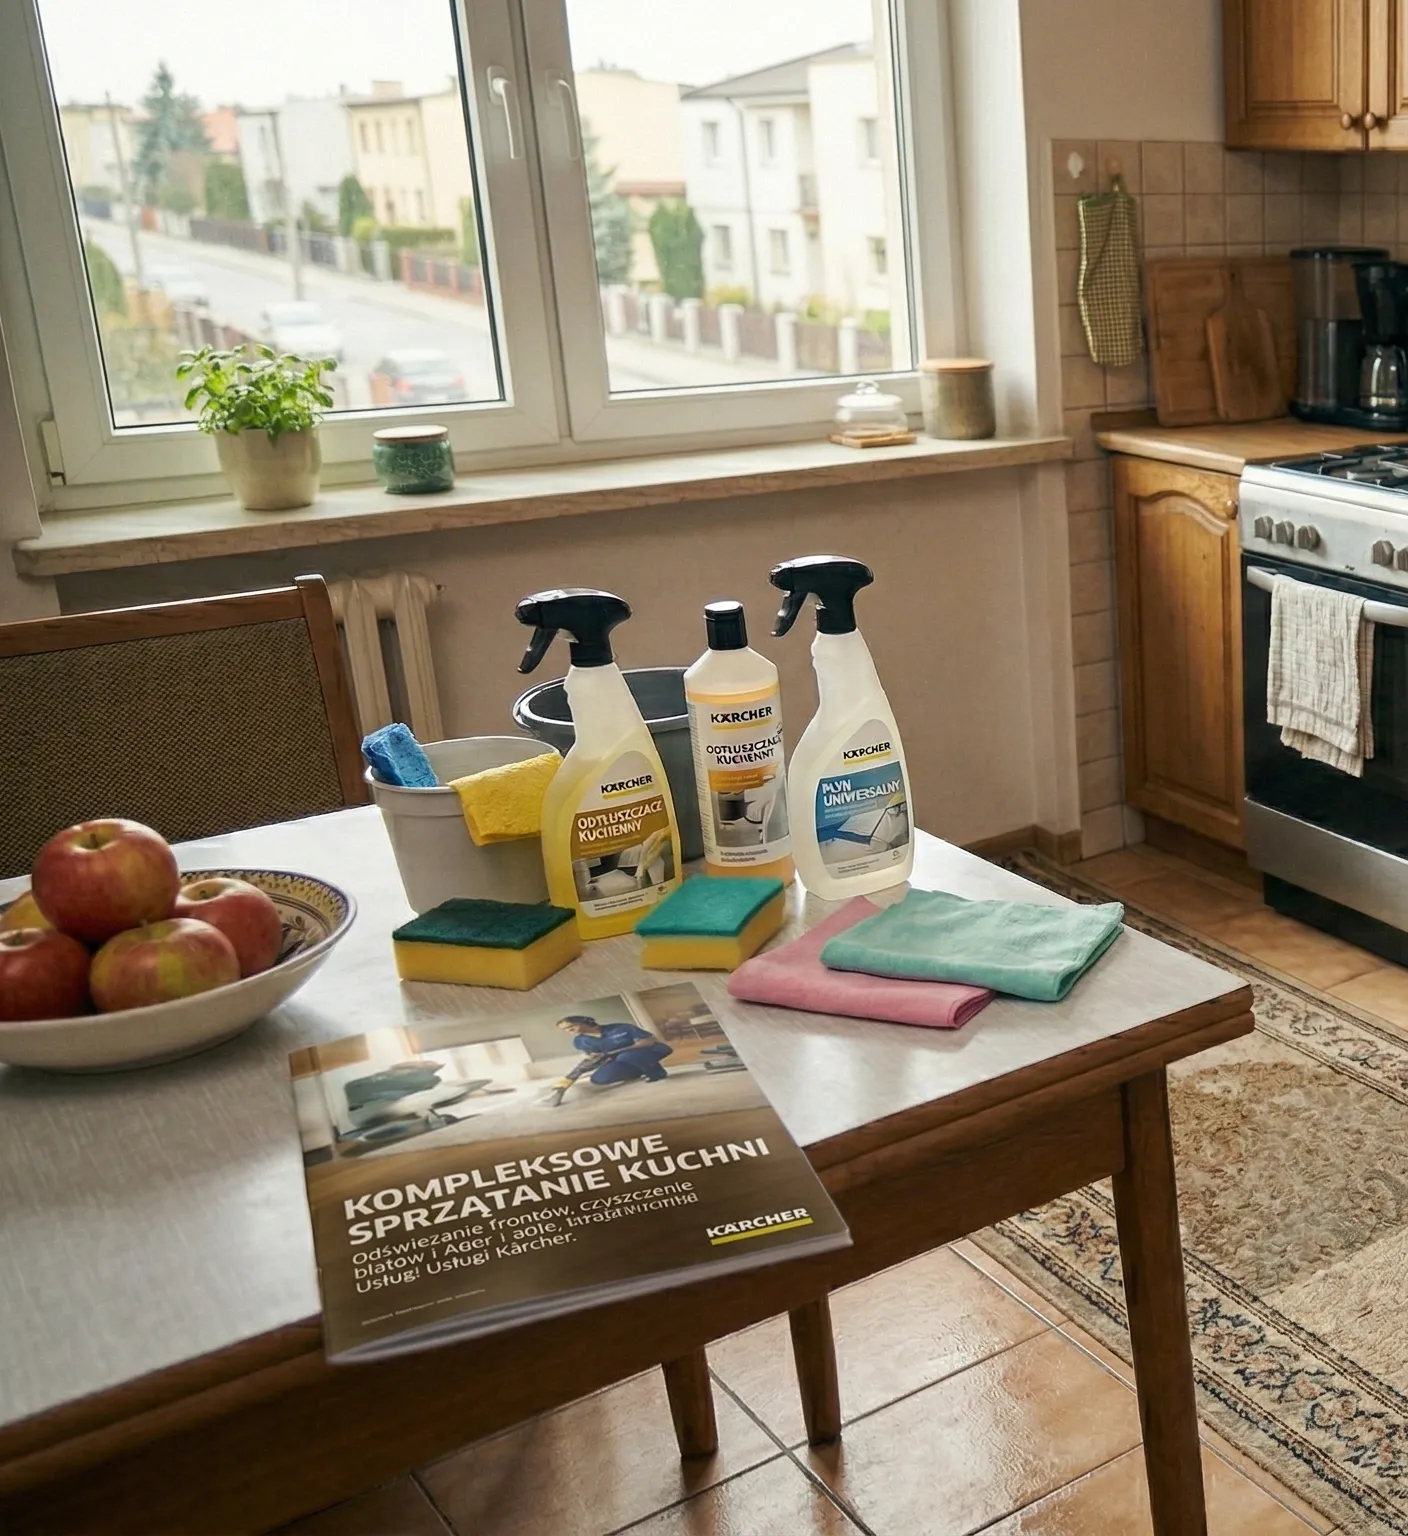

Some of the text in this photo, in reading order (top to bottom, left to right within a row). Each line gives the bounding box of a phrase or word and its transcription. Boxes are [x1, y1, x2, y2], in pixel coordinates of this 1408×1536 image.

[344, 1133, 669, 1221] KOMPLEKSOWE
[347, 1168, 611, 1246] SPRZĄTANIE
[617, 1137, 770, 1185] KUCHNI
[431, 1248, 437, 1260] i
